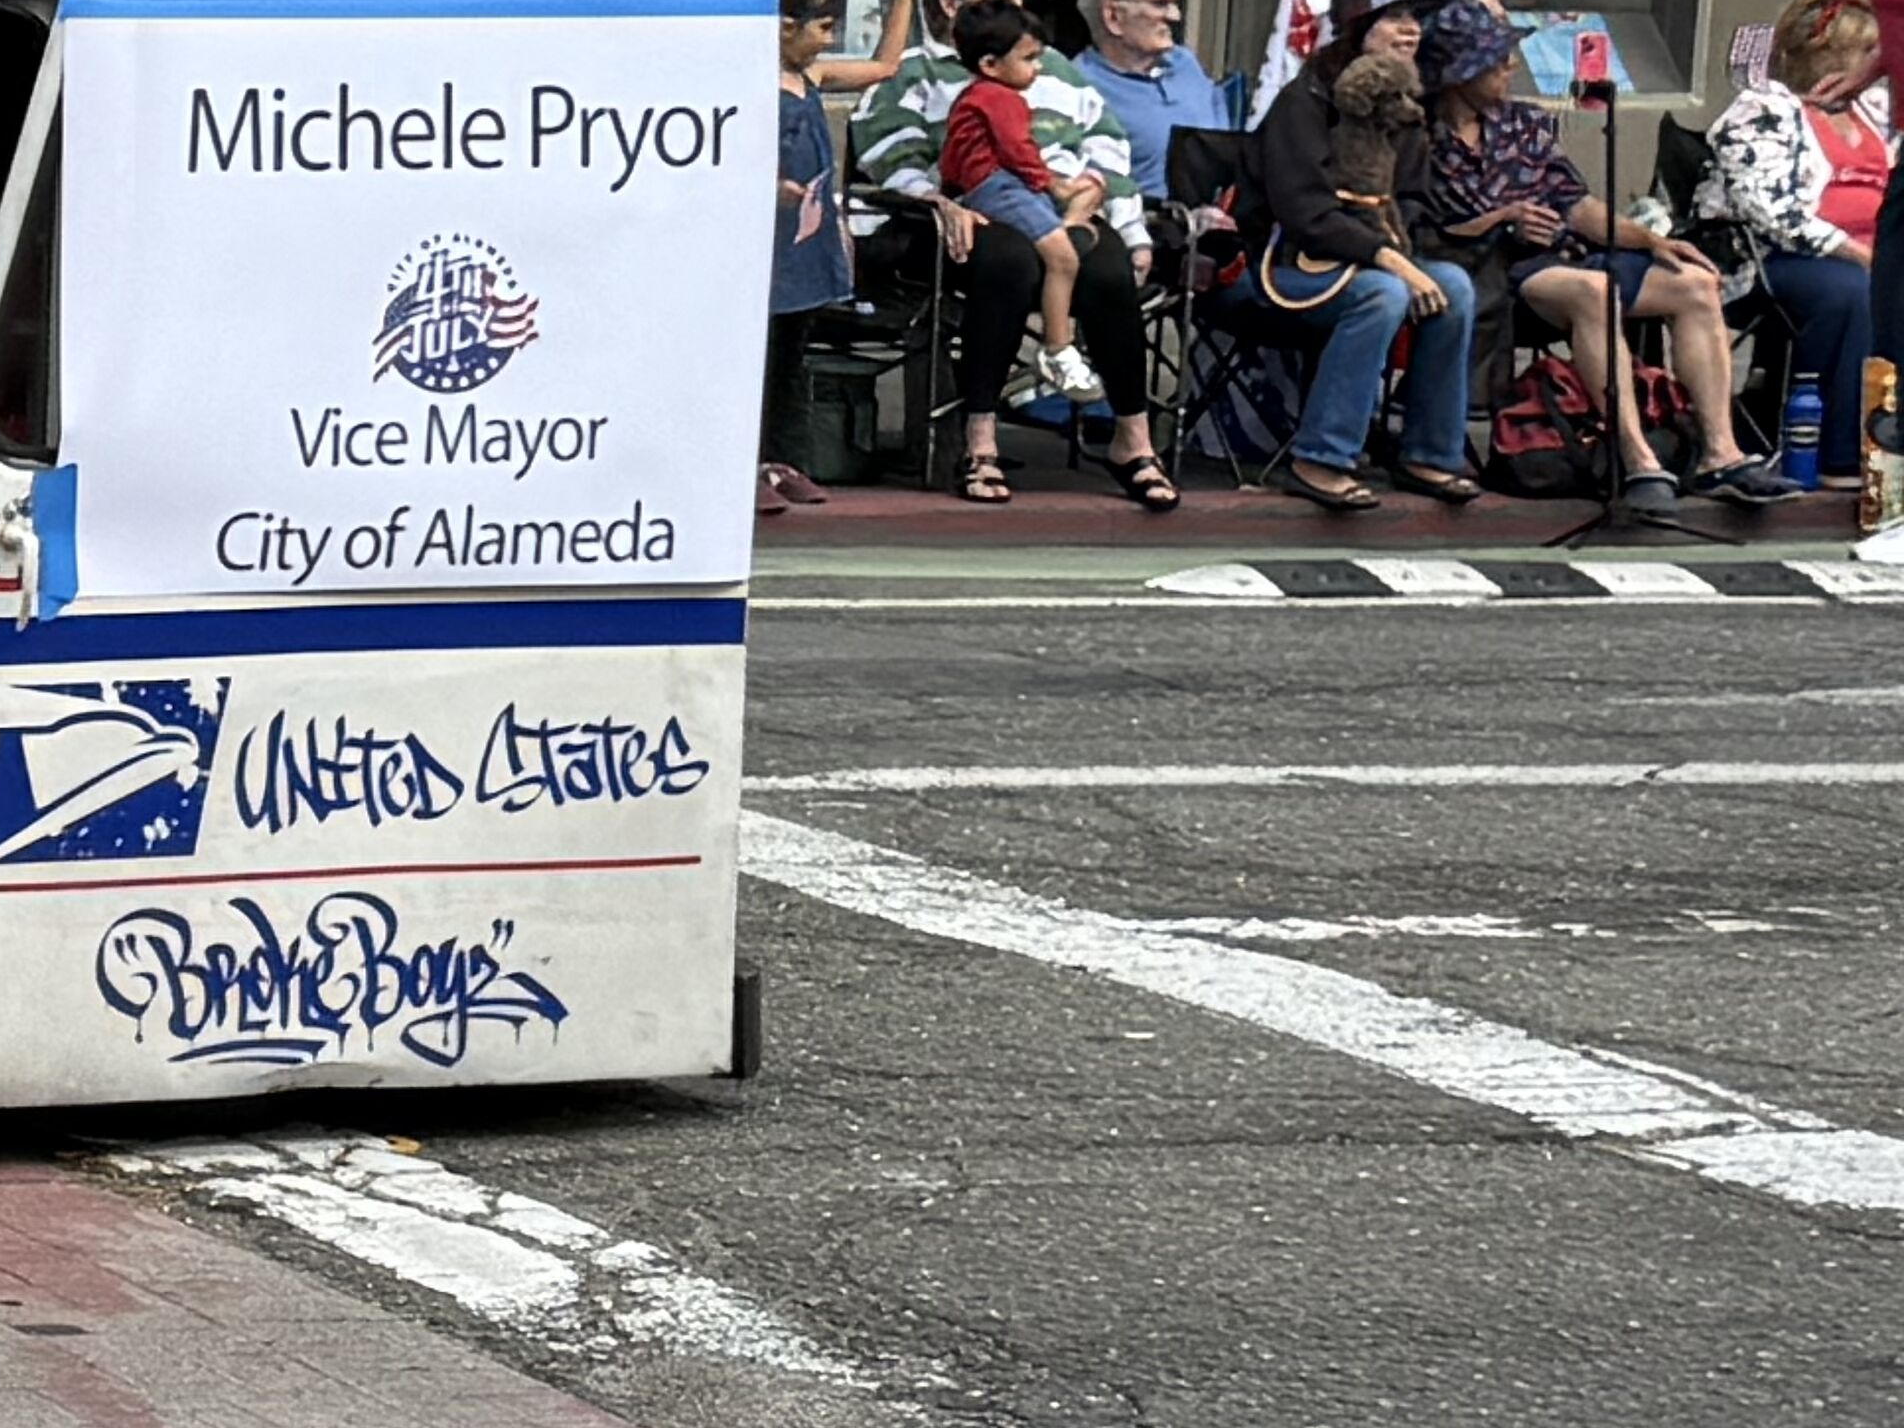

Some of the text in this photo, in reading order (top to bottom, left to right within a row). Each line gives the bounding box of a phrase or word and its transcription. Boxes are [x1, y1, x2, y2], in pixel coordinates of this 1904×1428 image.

[186, 81, 738, 192] Michele Pryor
[399, 302, 495, 364] JULY
[291, 403, 608, 480] Vice Mayor
[216, 501, 675, 586] City of Alameda
